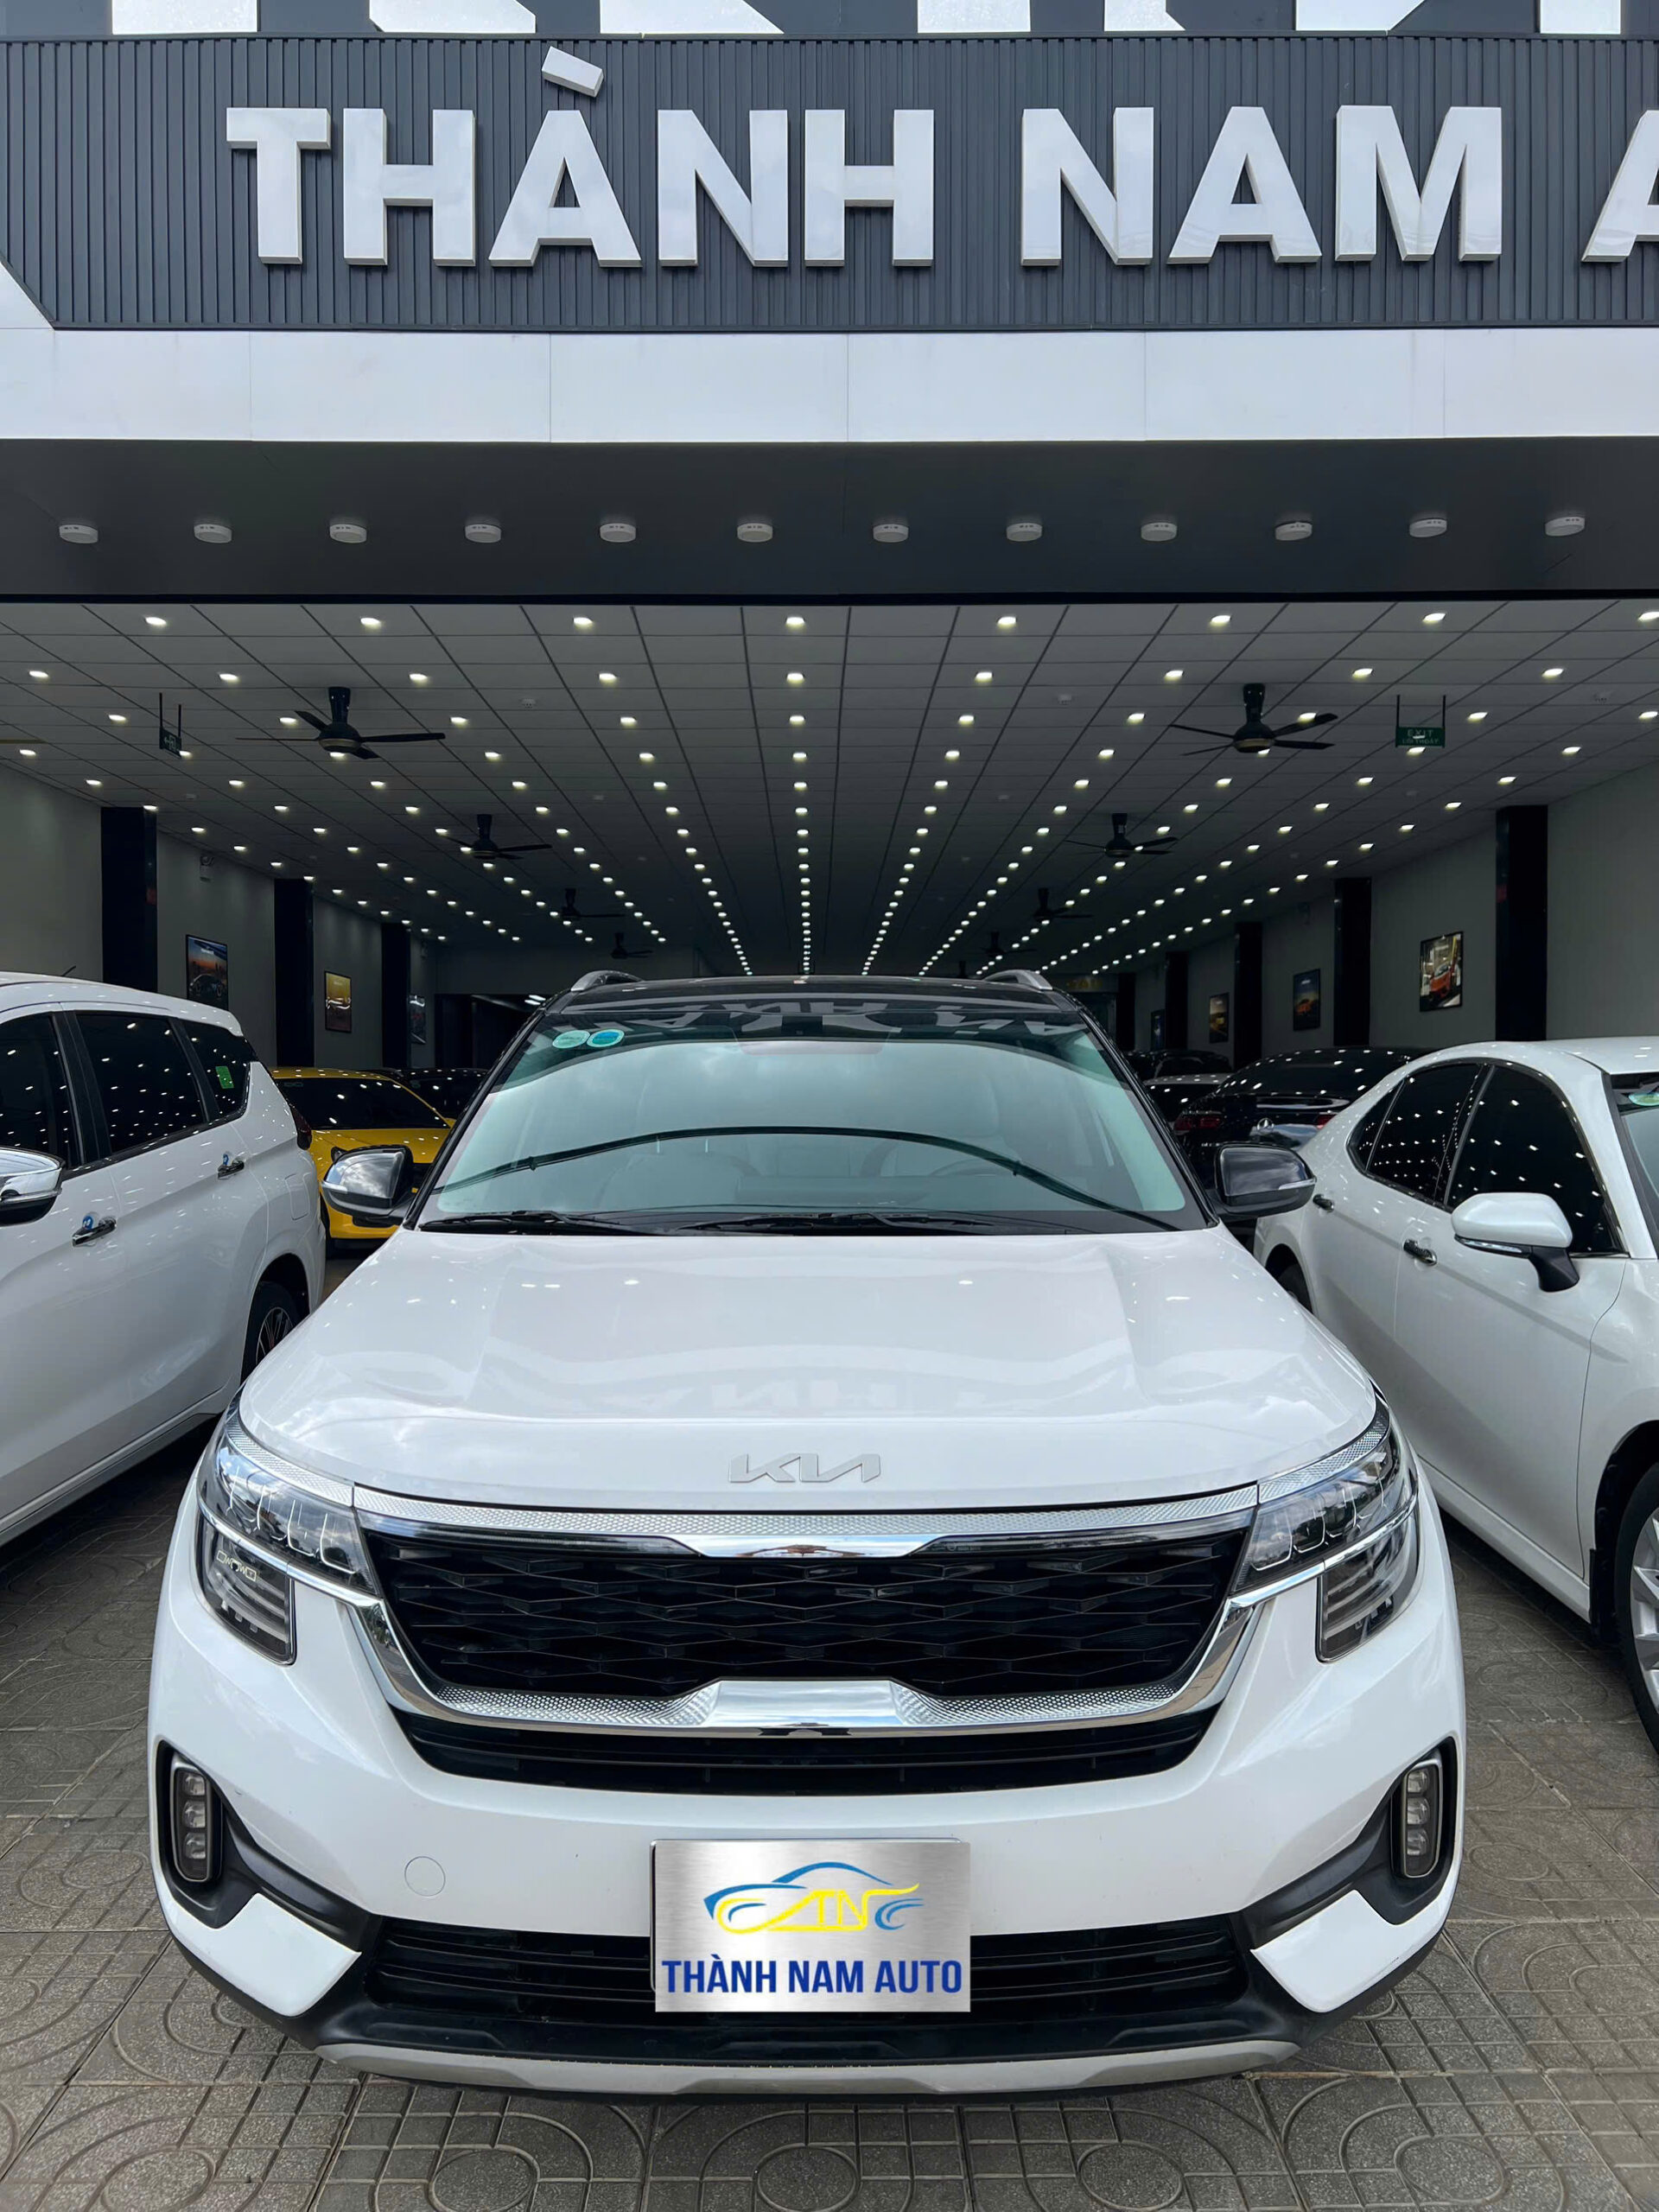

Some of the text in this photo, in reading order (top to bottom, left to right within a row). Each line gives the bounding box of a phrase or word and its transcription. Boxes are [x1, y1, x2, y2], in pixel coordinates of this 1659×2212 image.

[226, 46, 935, 268] THÀNH
[1020, 105, 1503, 266] NAM
[729, 1453, 880, 1483] KIA
